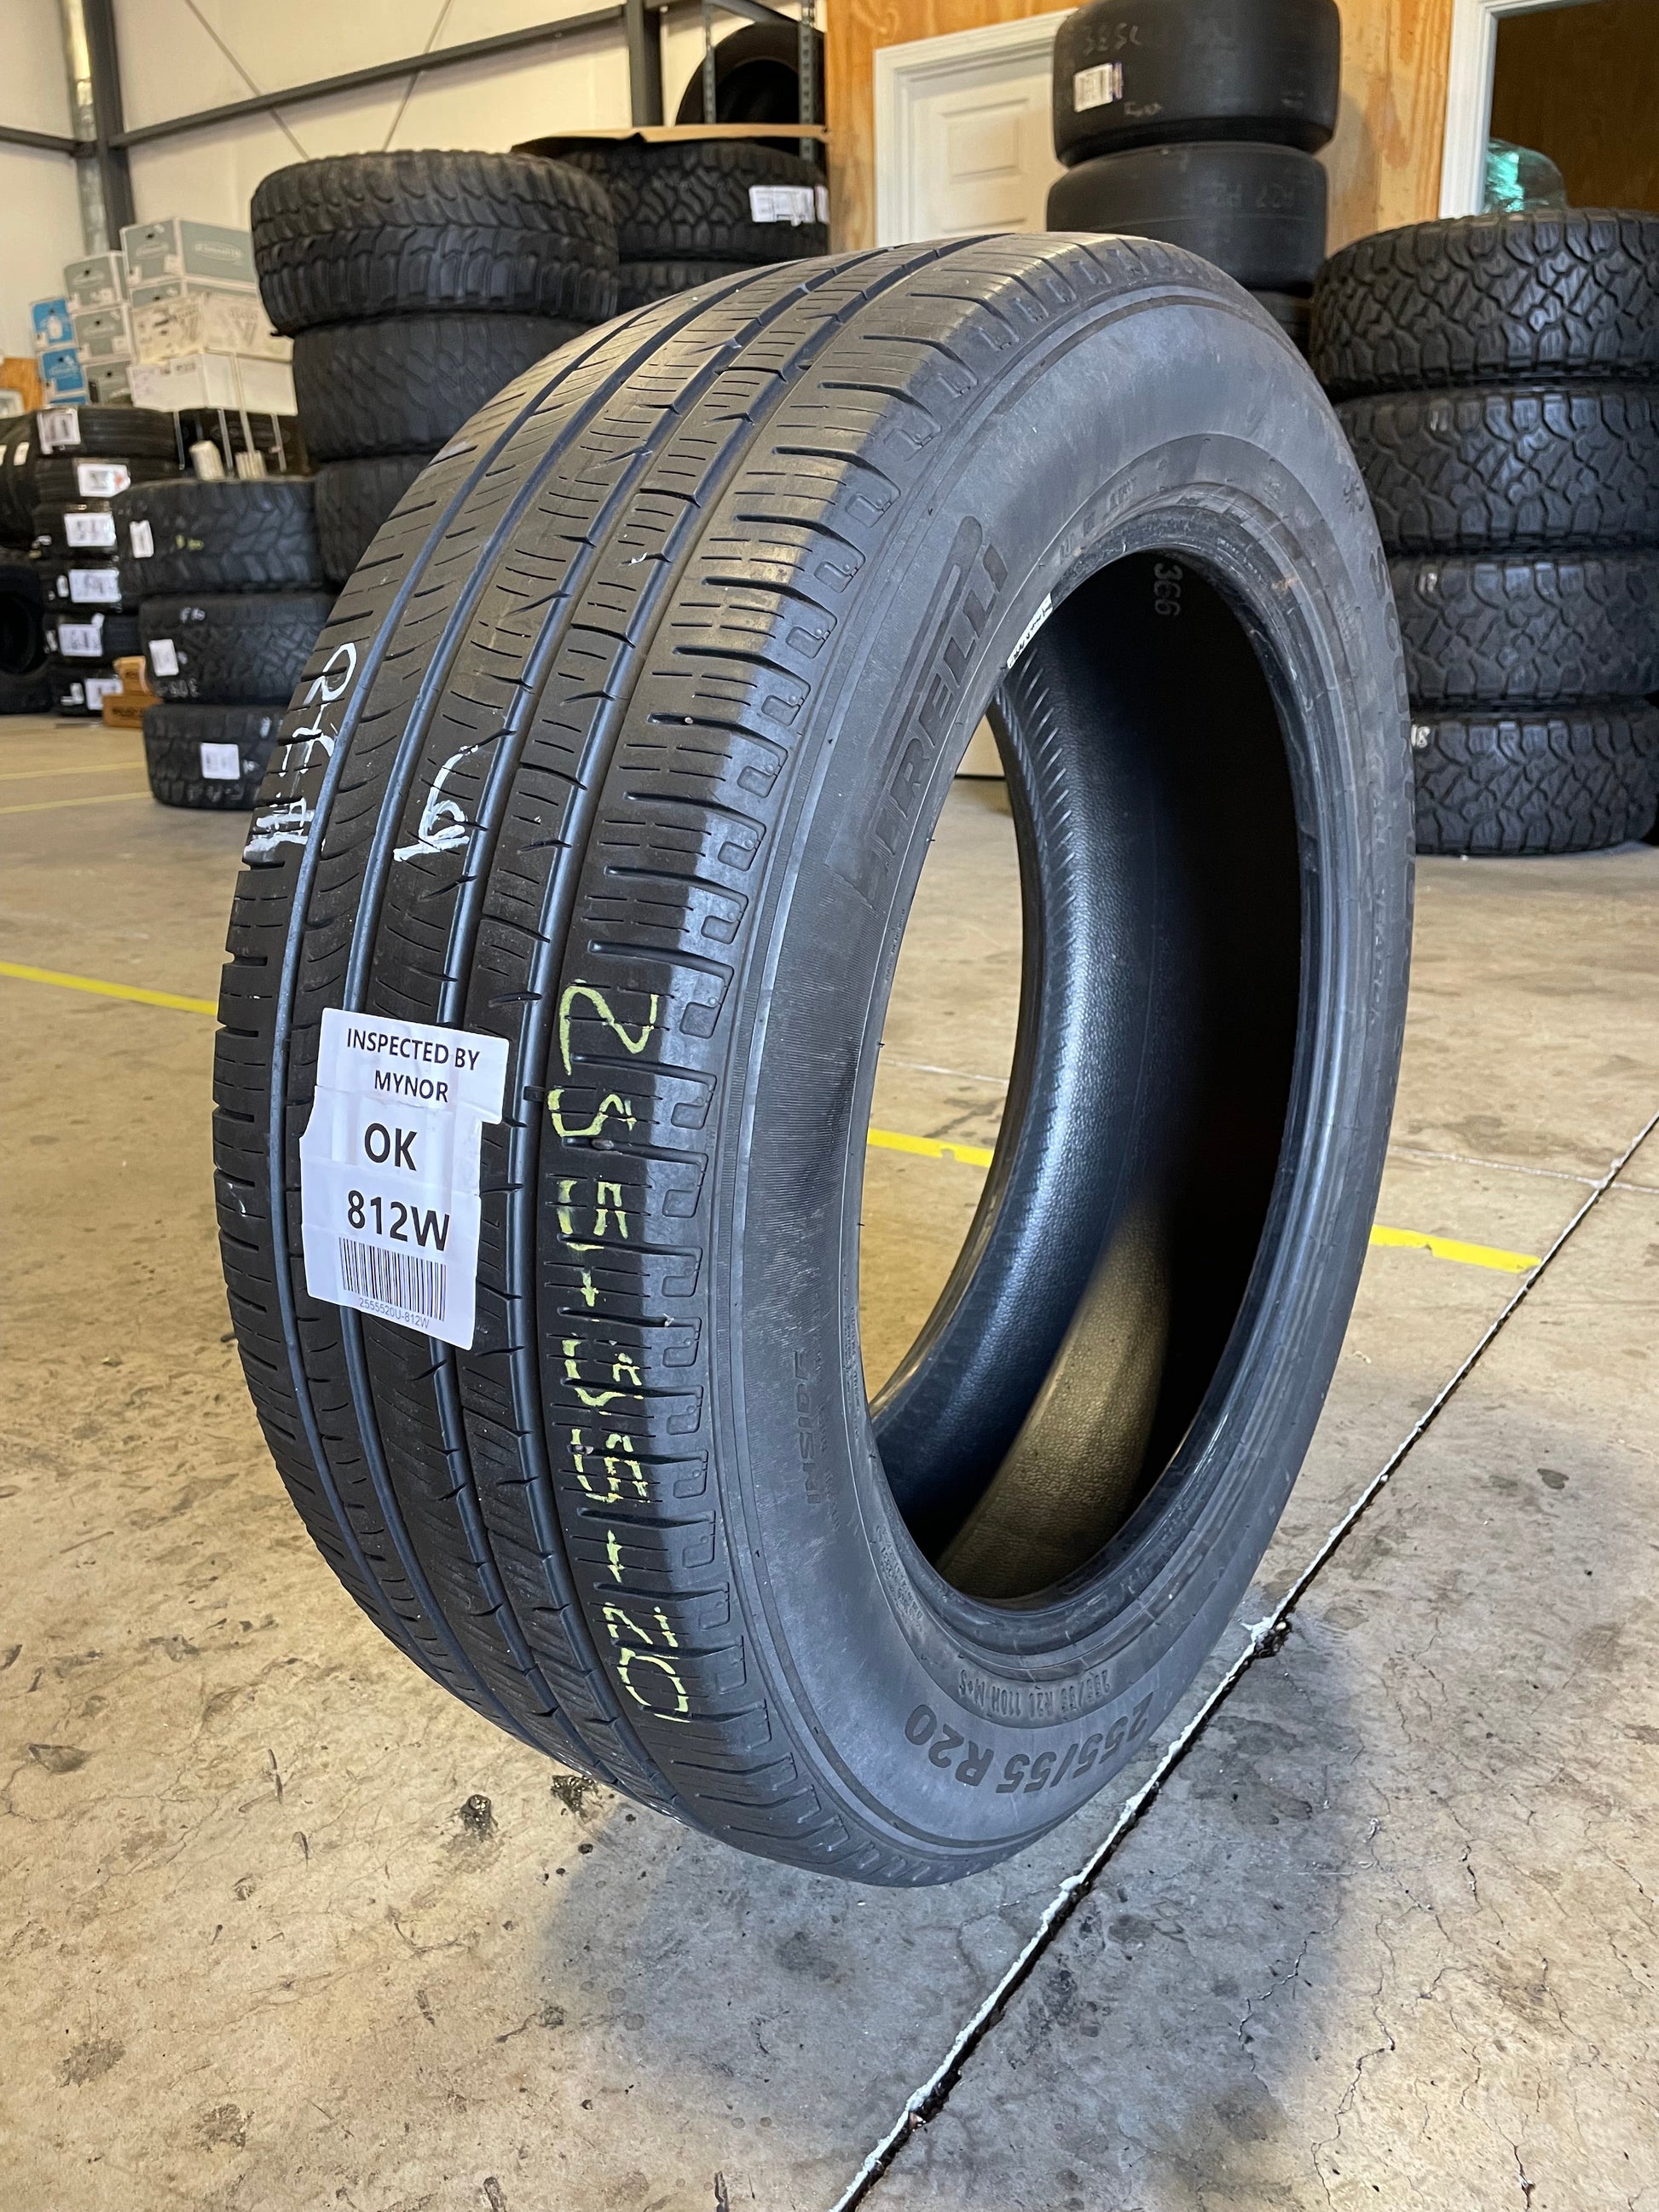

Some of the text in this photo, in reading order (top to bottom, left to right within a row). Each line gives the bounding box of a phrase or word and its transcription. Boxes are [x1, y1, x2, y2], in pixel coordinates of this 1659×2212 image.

[346, 1027, 481, 1071] INSPECTED BY
[374, 1070, 449, 1103] MYNOR
[364, 1122, 419, 1172] OK
[347, 1189, 451, 1252] 812W
[359, 1297, 431, 1330] 2555520U-812W
[905, 1691, 1154, 1793] 255/55 R20
